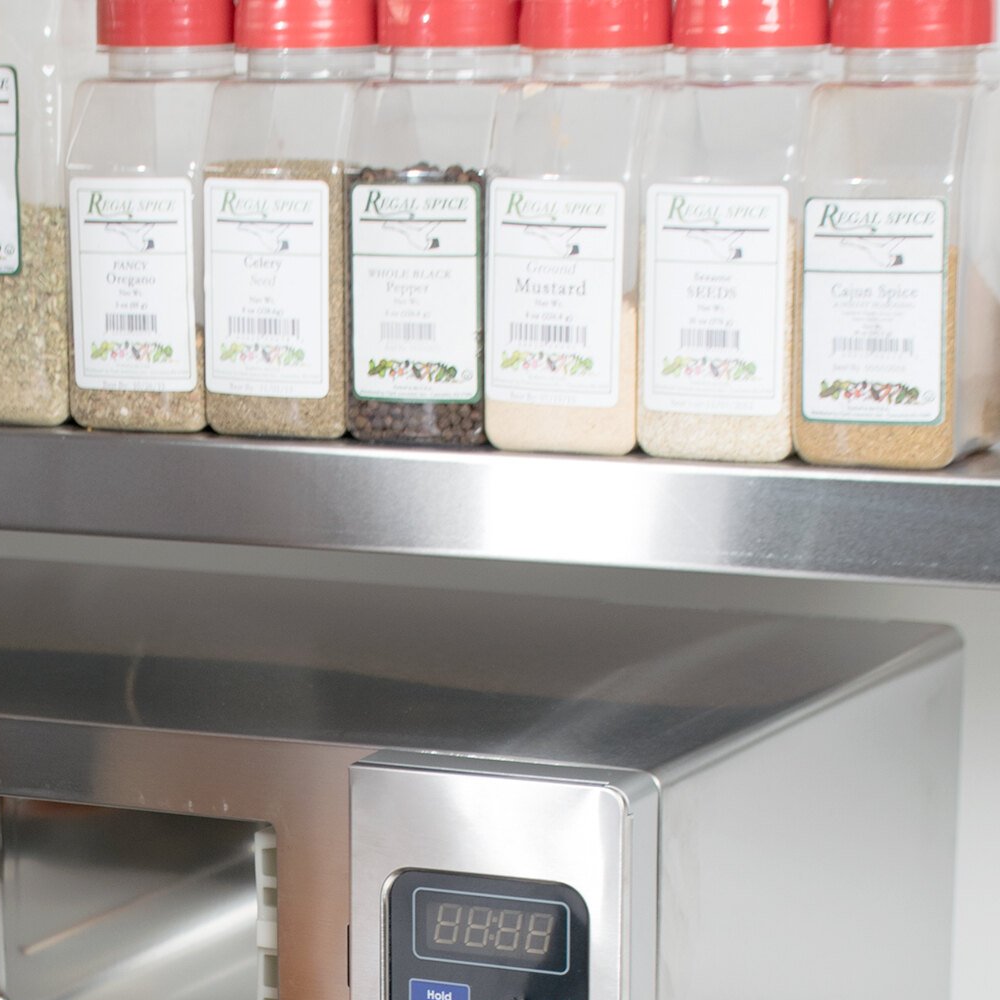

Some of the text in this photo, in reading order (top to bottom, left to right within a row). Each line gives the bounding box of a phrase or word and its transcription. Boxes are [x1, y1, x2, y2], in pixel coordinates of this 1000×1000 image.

[88, 191, 175, 214] REGAL SPICE
[220, 189, 312, 213] REGAL SPICE
[364, 190, 468, 214] REGAL SPICE
[505, 191, 606, 216] REGAL SPICE
[667, 194, 769, 220] REGAL SPICE
[817, 203, 936, 228] REGAL SPICE
[244, 256, 282, 271] Celery
[105, 272, 156, 287] Oregano
[514, 278, 587, 296] Mustard
[830, 283, 919, 304] Cajun Spice
